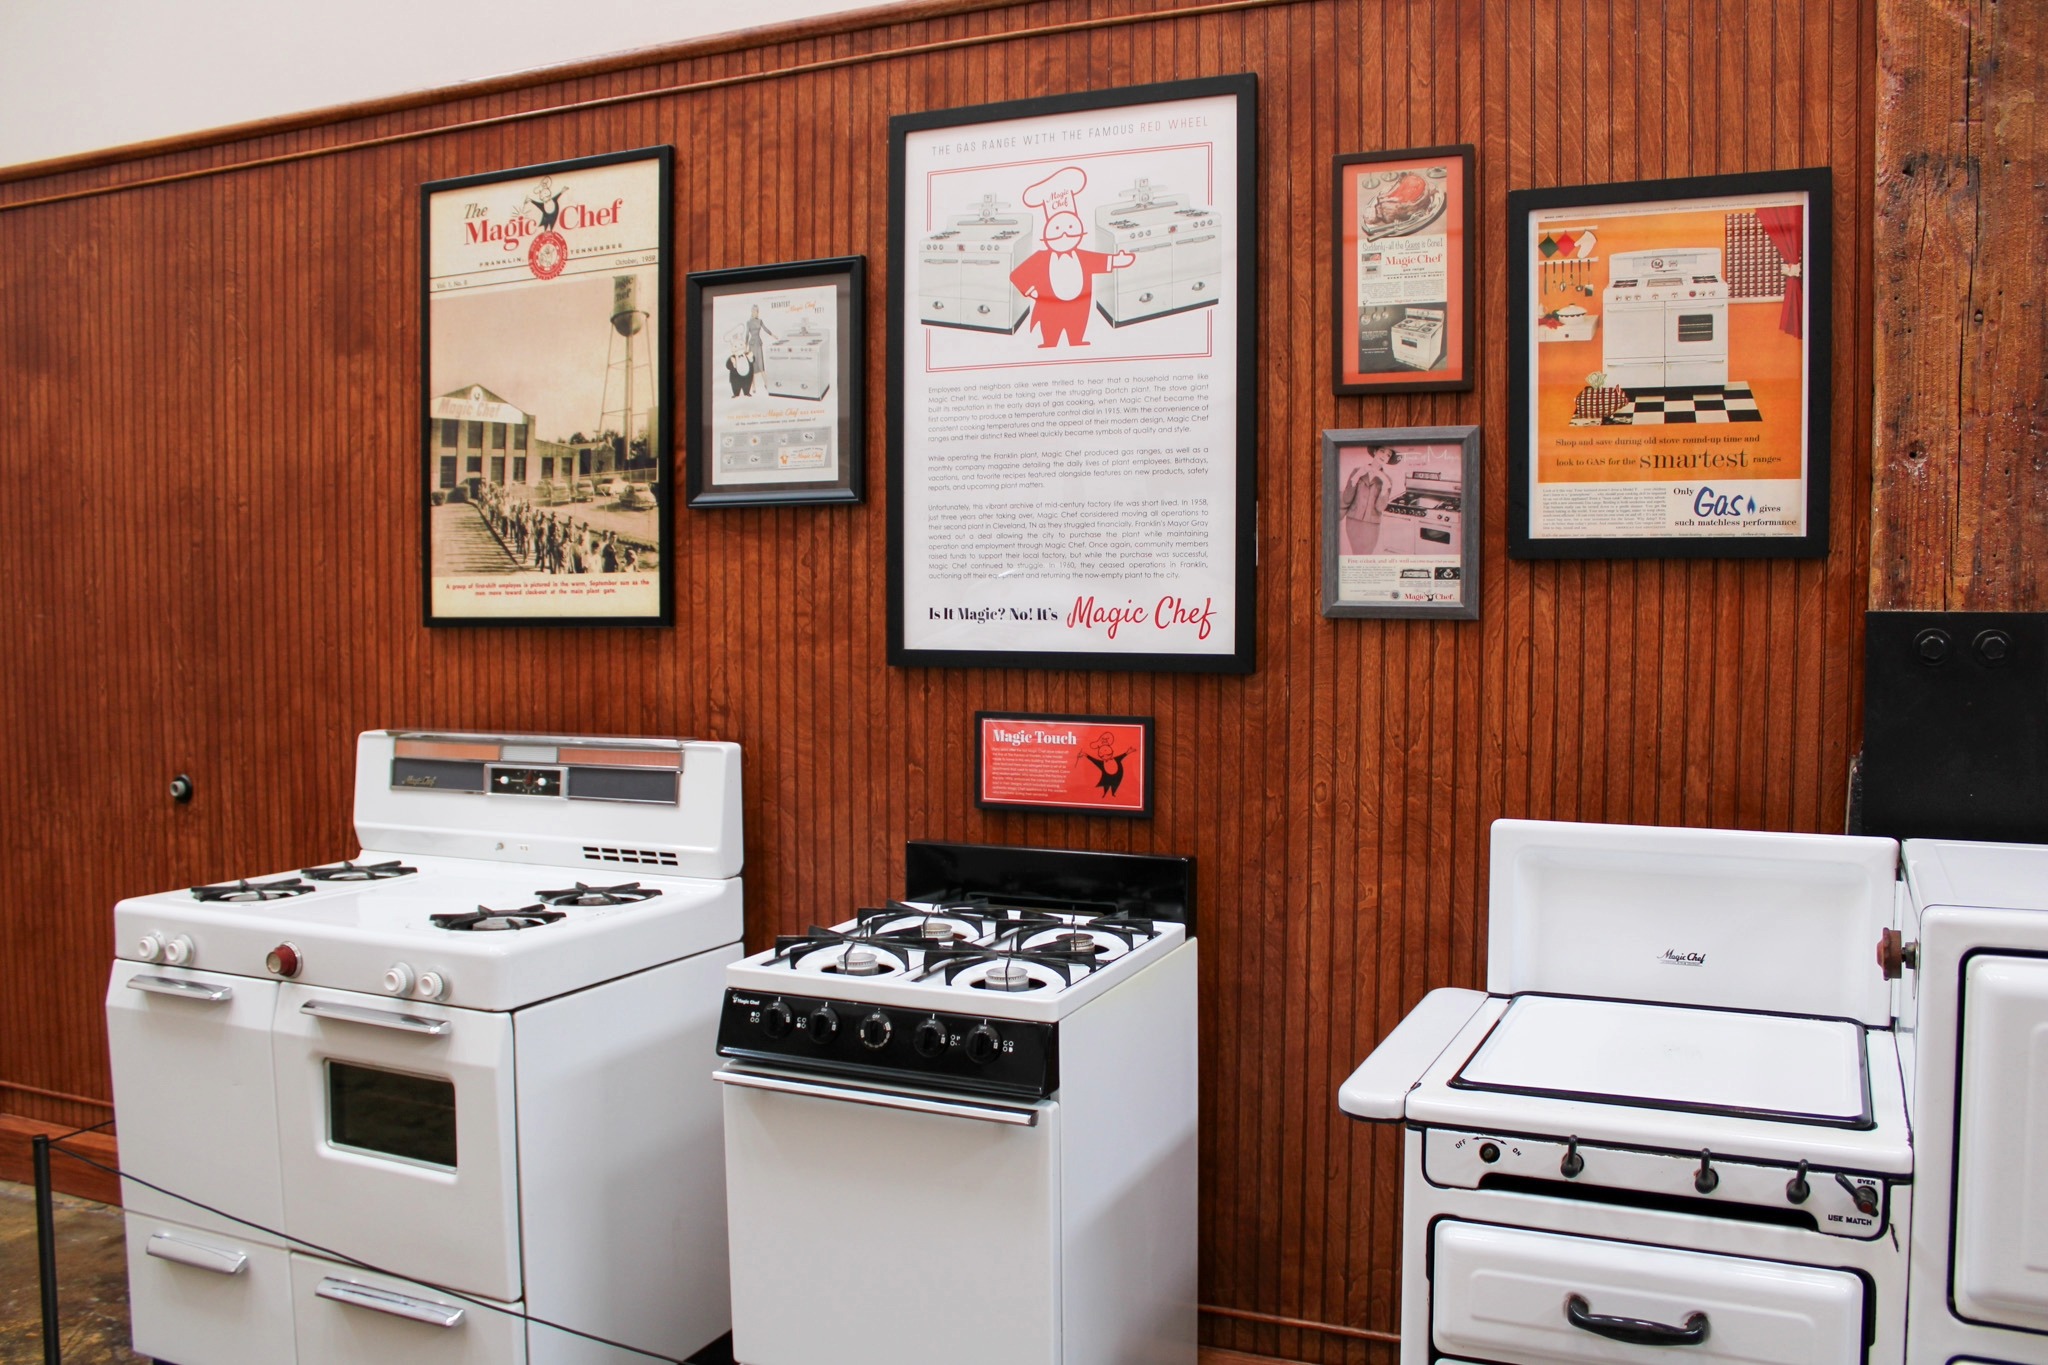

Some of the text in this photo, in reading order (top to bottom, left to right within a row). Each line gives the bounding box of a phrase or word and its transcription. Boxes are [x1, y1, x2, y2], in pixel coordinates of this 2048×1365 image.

[932, 116, 1208, 155] THE GAS RANGE WITH THE FAMOUS RED WHEEL
[1052, 196, 1068, 210] Chef
[464, 203, 488, 219] The
[464, 198, 623, 251] Magic Chef
[571, 243, 622, 254] TENNESSEE
[1386, 253, 1442, 267] Magic Chef
[979, 383, 1012, 392] neighbors
[1069, 389, 1103, 397] struggling
[1190, 384, 1209, 392] giant
[1556, 438, 1576, 448] Shop
[1614, 438, 1642, 446] during
[1682, 436, 1720, 444] round-up
[1041, 451, 1062, 459] Magic
[1084, 449, 1119, 457] produced
[1639, 448, 1749, 469] smartest
[1673, 486, 1781, 518] Only Gas gives
[1742, 518, 1796, 528] performance
[929, 596, 1217, 640] Is It Magic? No! It's Magic Chef
[993, 730, 1076, 746] Magic Touch
[1657, 949, 1686, 962] Magic
[1687, 952, 1706, 964] Chef
[1455, 1139, 1466, 1148] OFF
[1512, 1148, 1522, 1156] ON
[1828, 1214, 1872, 1226] USE MATCH
